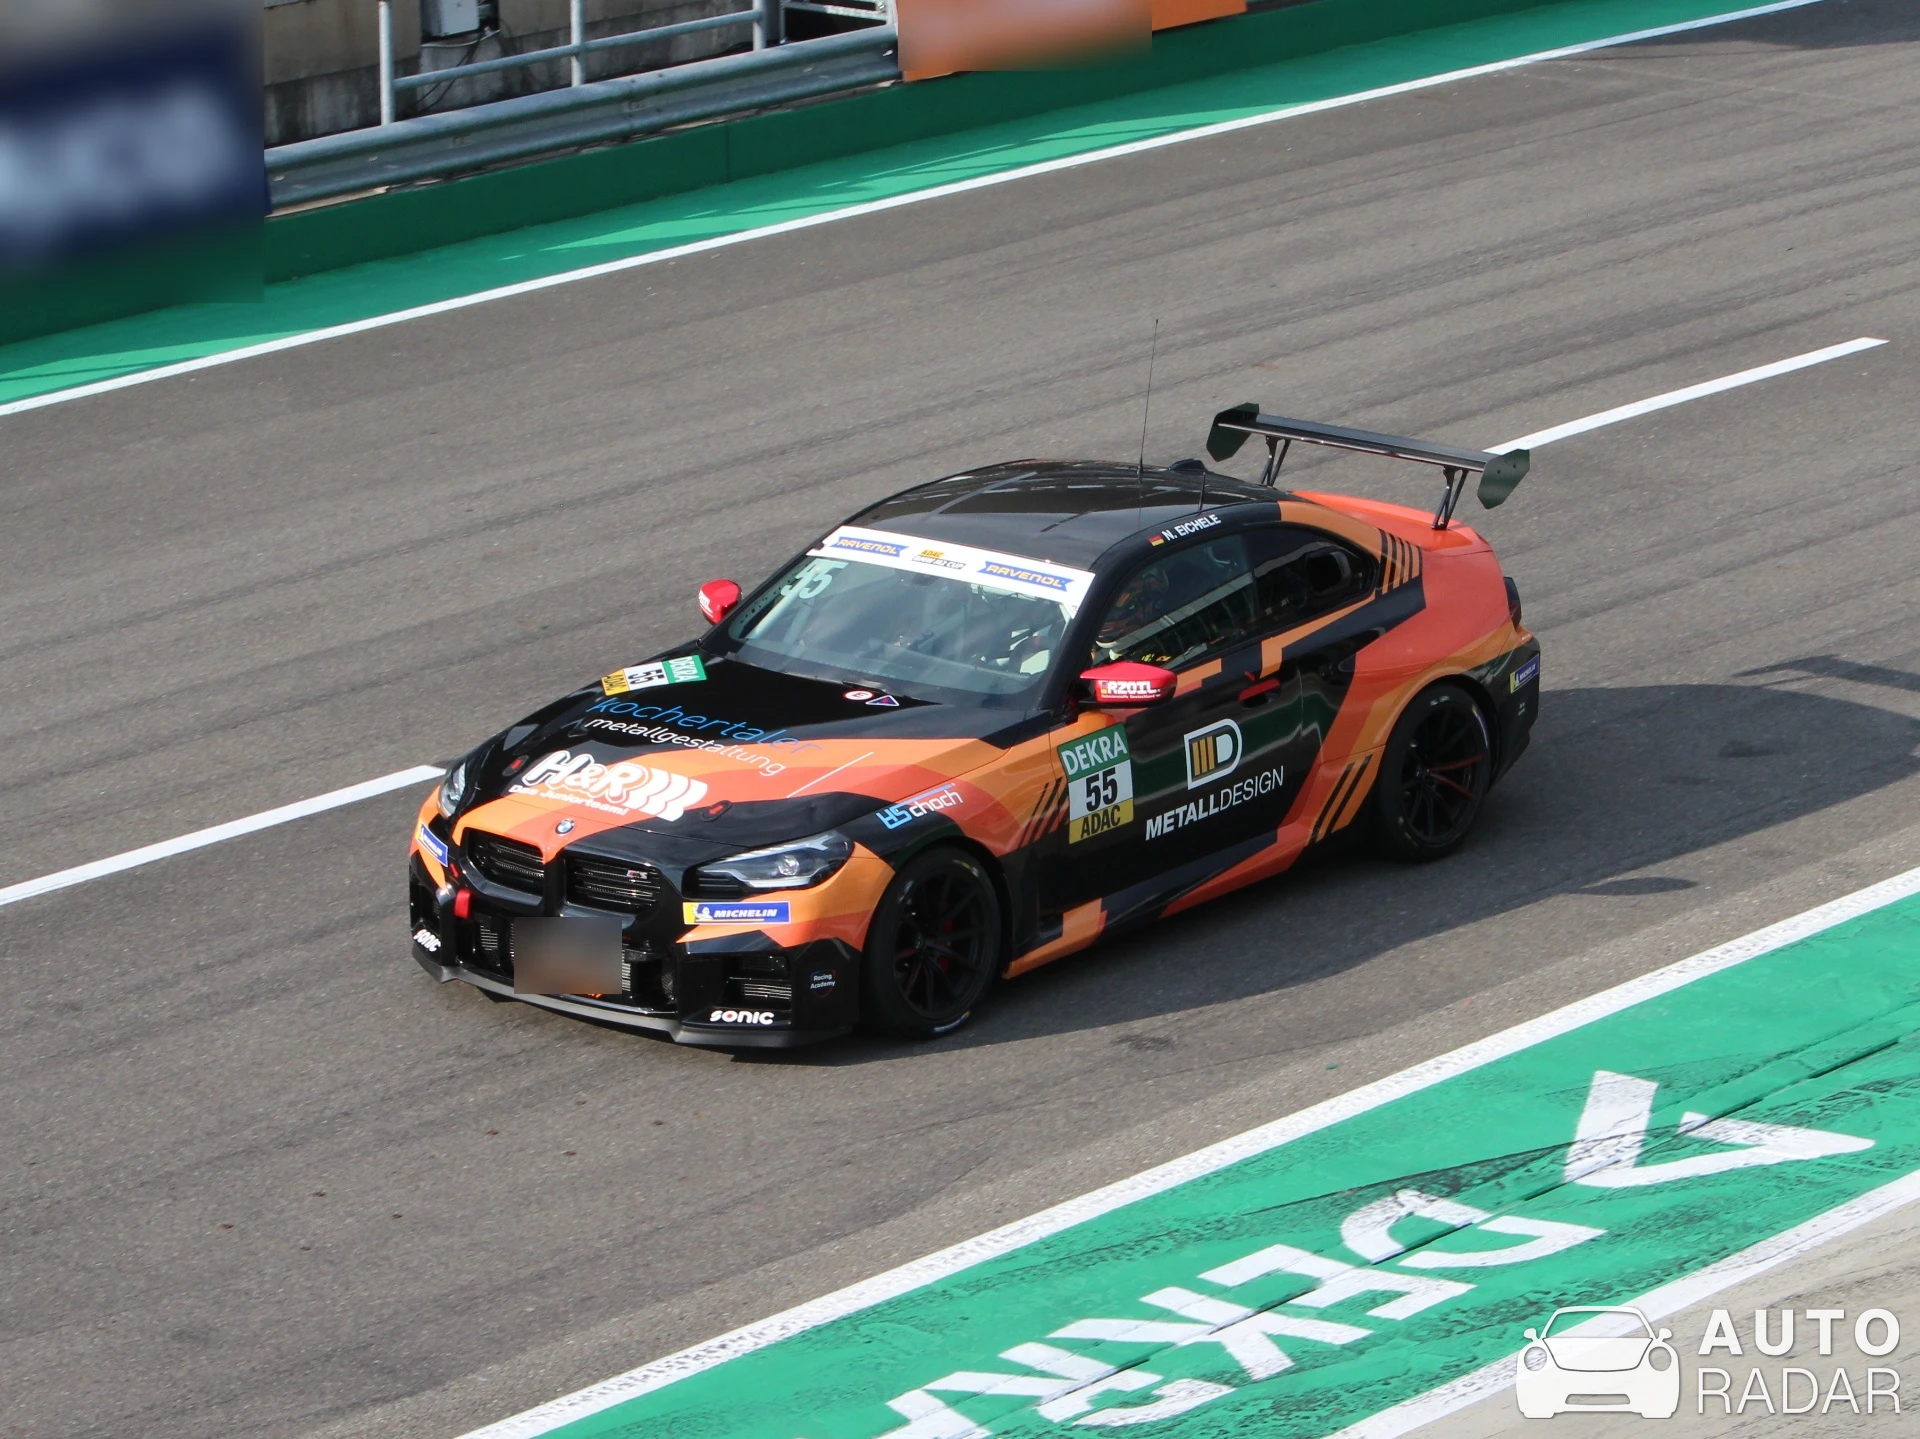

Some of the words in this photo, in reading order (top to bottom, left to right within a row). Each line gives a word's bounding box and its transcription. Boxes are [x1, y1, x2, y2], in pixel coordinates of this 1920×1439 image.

[1161, 529, 1178, 541] N.
[1174, 514, 1222, 537] EICHELE
[836, 539, 901, 556] RAVENOL
[985, 564, 1064, 588] RAVENOL
[627, 668, 666, 686] 55
[586, 697, 823, 755] kochertaler
[584, 717, 787, 777] metallgestaltung
[1060, 731, 1128, 776] DEKRA
[522, 750, 648, 804] H&R
[1085, 767, 1118, 812] 55
[1080, 805, 1121, 839] ADAC
[713, 908, 778, 918] MICHELIN
[810, 980, 836, 990] Academy
[813, 973, 833, 982] Racing
